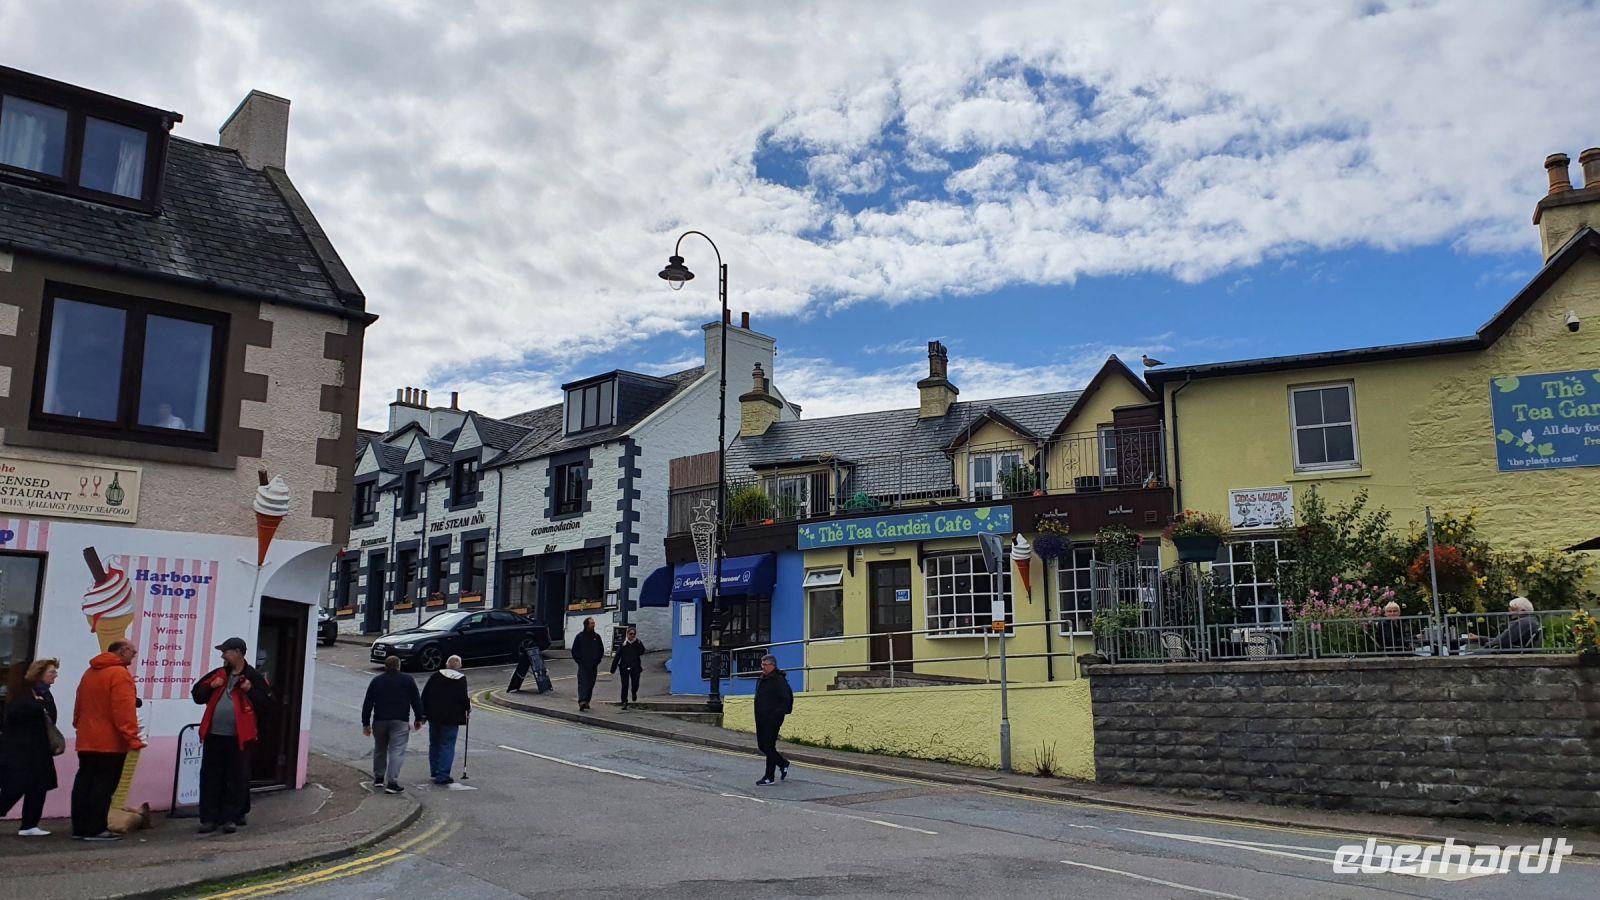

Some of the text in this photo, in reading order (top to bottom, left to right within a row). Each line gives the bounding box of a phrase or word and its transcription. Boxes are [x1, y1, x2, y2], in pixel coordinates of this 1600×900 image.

[1541, 380, 1586, 399] The
[1511, 404, 1555, 422] Tea
[1542, 425, 1560, 435] All
[1561, 424, 1582, 435] day
[1526, 457, 1550, 467] place
[0, 463, 16, 473] he
[1258, 491, 1288, 502] WELCOME
[66, 504, 95, 513] FINEST
[95, 506, 130, 515] SEAFOOD
[430, 514, 486, 532] THE STEAM INN
[818, 515, 972, 543] The Tea Garden Cafe
[360, 536, 388, 546] Restaurant
[544, 544, 557, 552] Bar
[135, 569, 213, 584] Harbour
[150, 584, 196, 599] Shop
[143, 611, 197, 620] Newsagents
[156, 626, 183, 635] Wines
[153, 642, 182, 652] Spirits
[161, 659, 191, 667] Drinks
[132, 675, 196, 684] Confectionary
